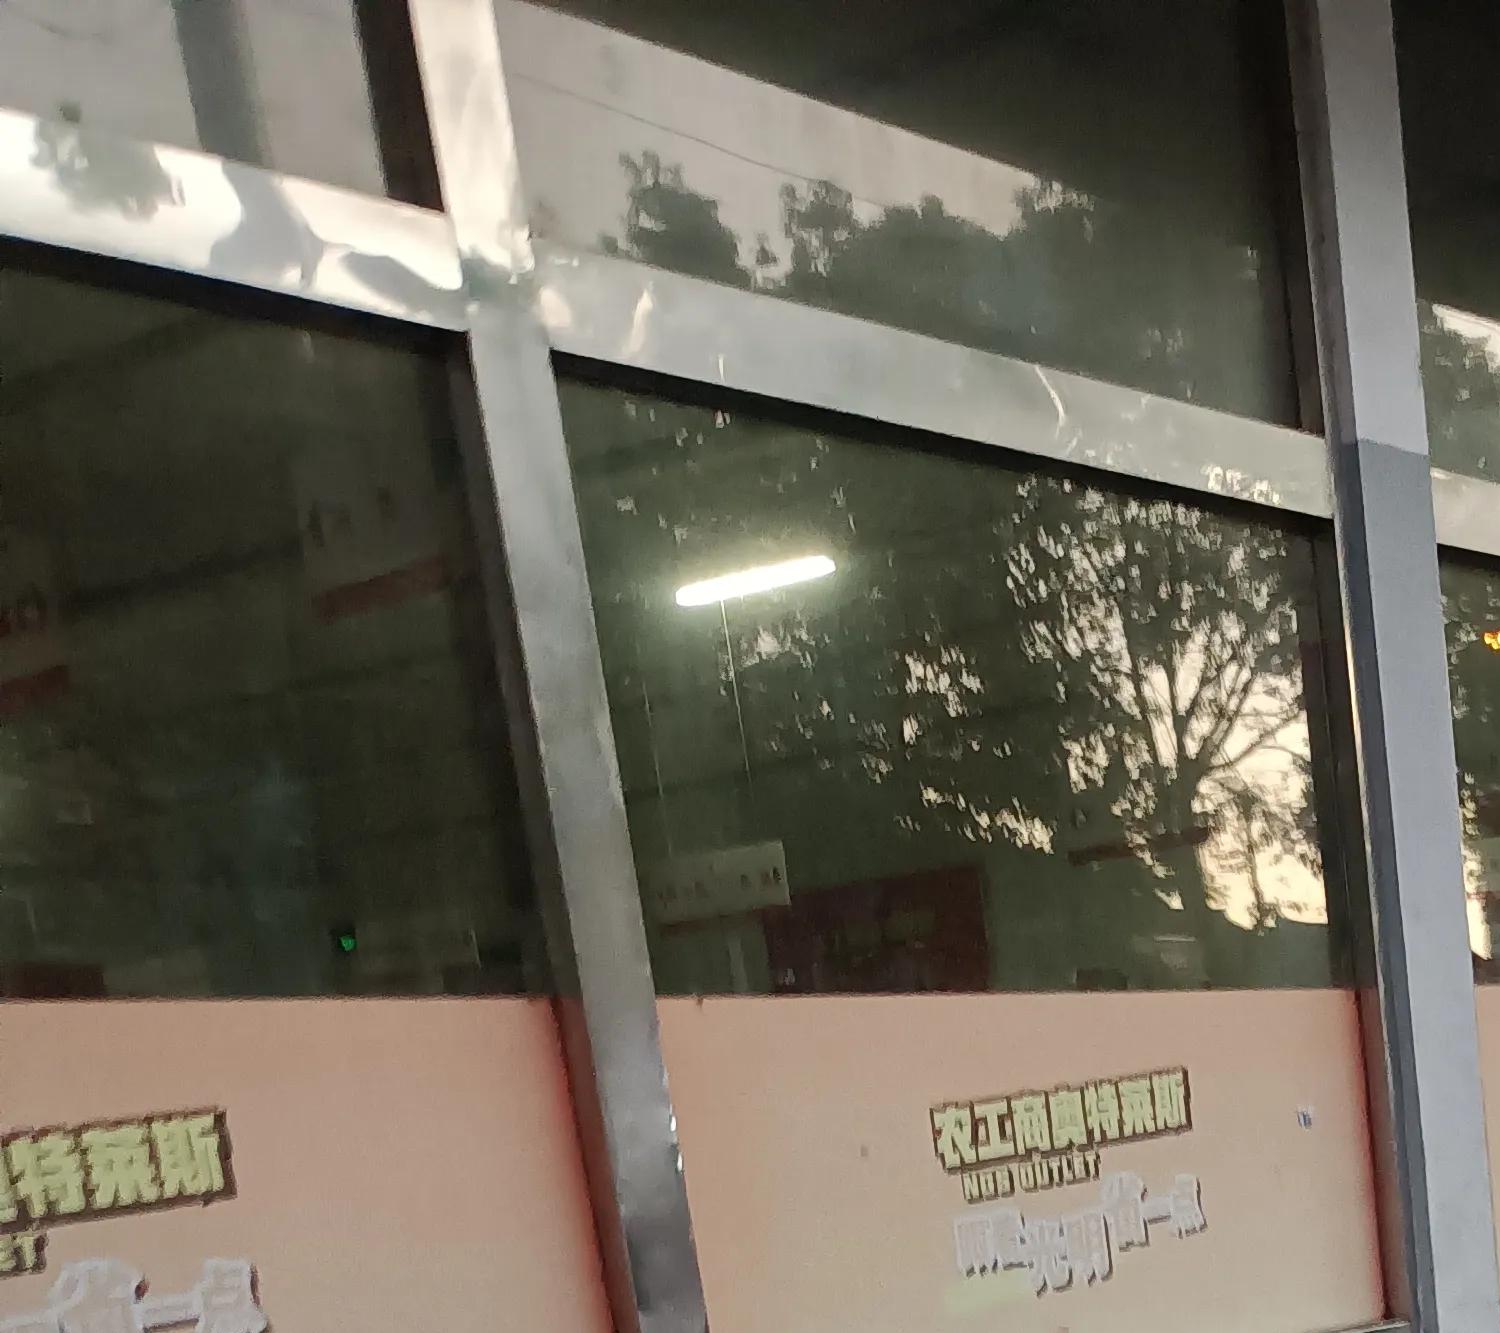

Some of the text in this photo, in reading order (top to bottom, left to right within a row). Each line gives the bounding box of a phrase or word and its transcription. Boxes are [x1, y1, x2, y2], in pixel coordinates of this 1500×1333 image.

[0, 1111, 226, 1223] 特莱斯
[934, 1069, 1188, 1171] 农工商奥特莱斯
[1018, 1151, 1100, 1192] OUTLET
